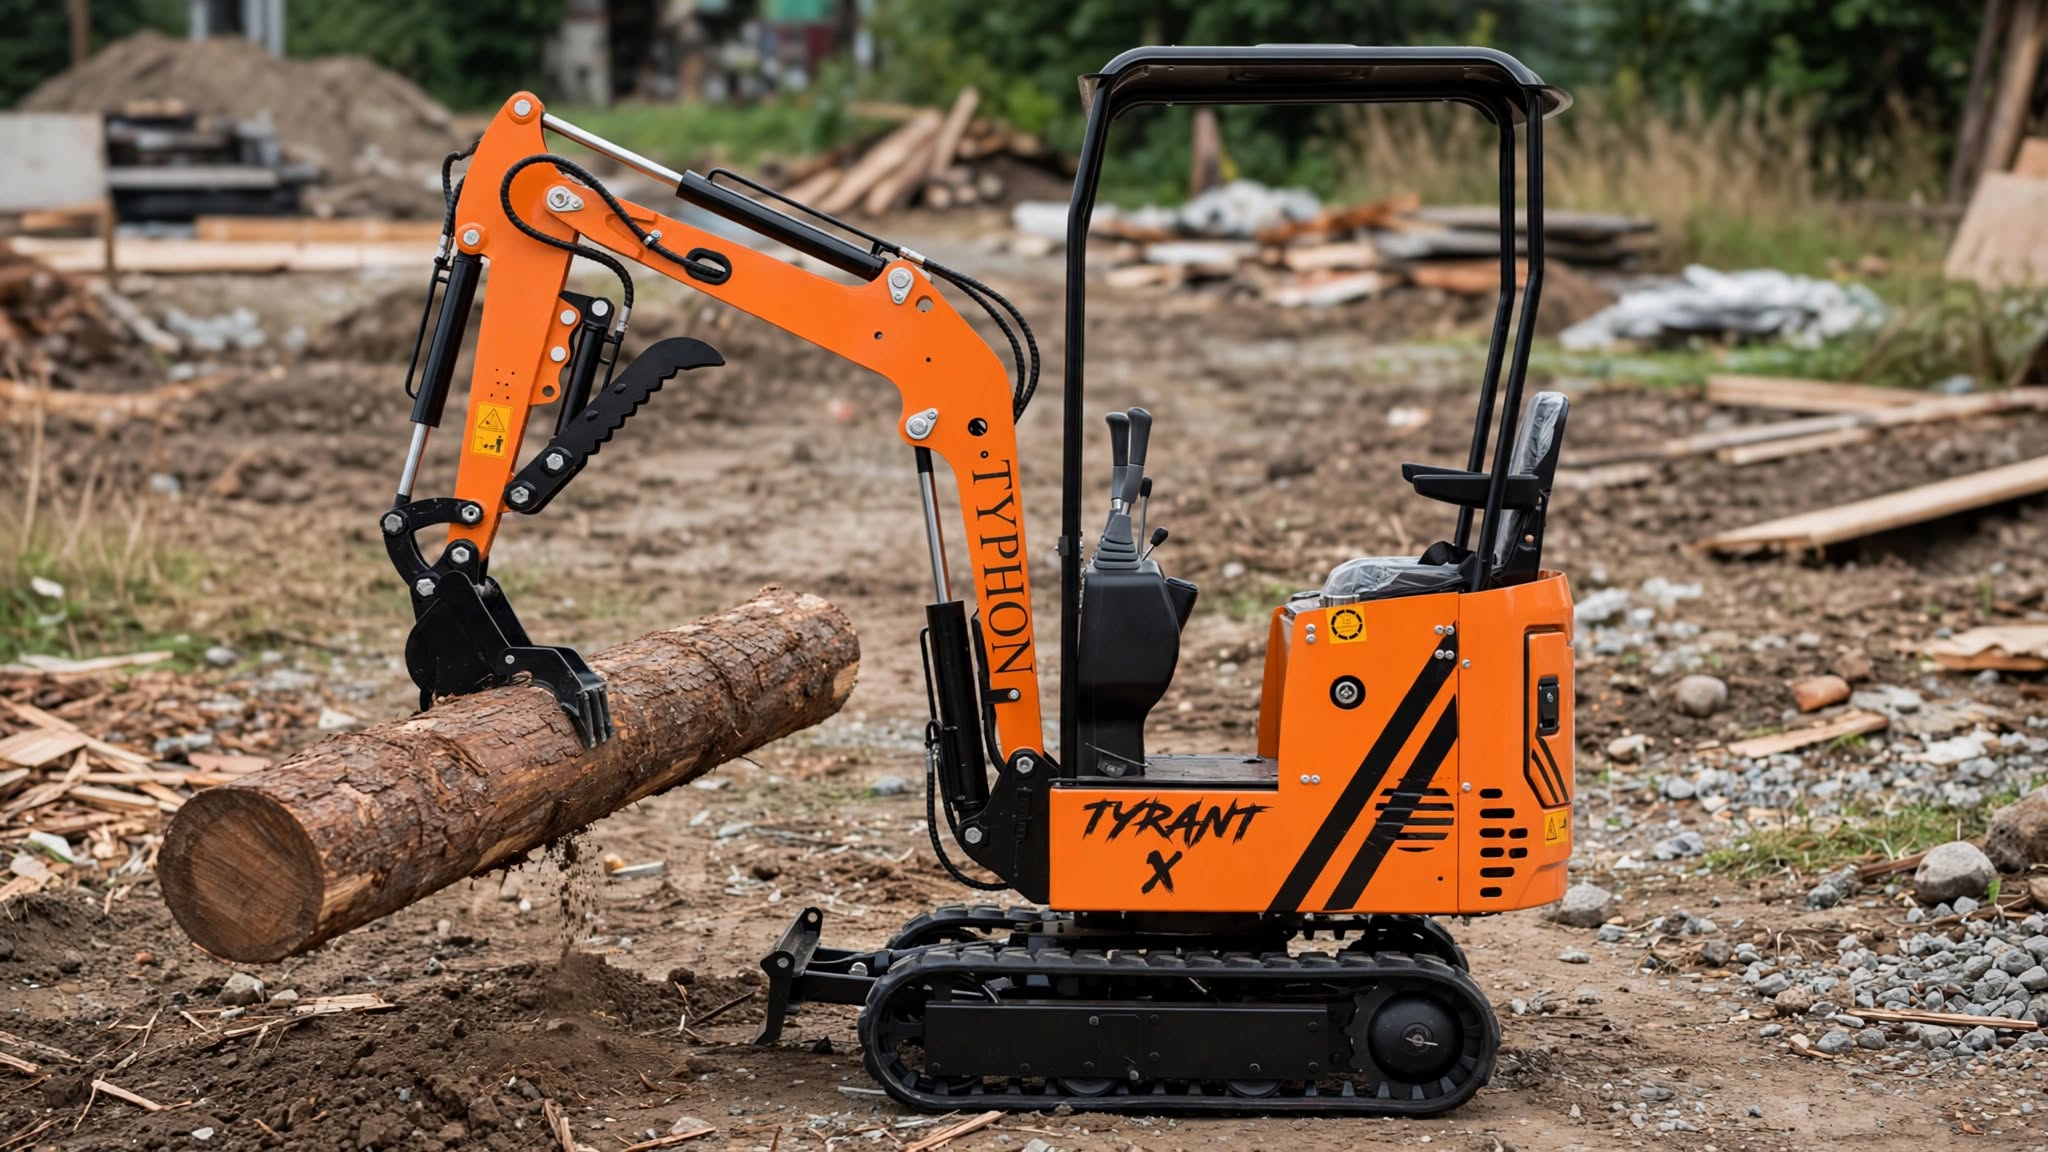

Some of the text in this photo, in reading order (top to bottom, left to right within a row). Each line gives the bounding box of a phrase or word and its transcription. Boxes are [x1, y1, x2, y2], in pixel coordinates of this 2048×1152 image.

[972, 459, 1034, 674] TYPHON
[1083, 796, 1272, 849] TYRANT
[1141, 850, 1183, 896] X
